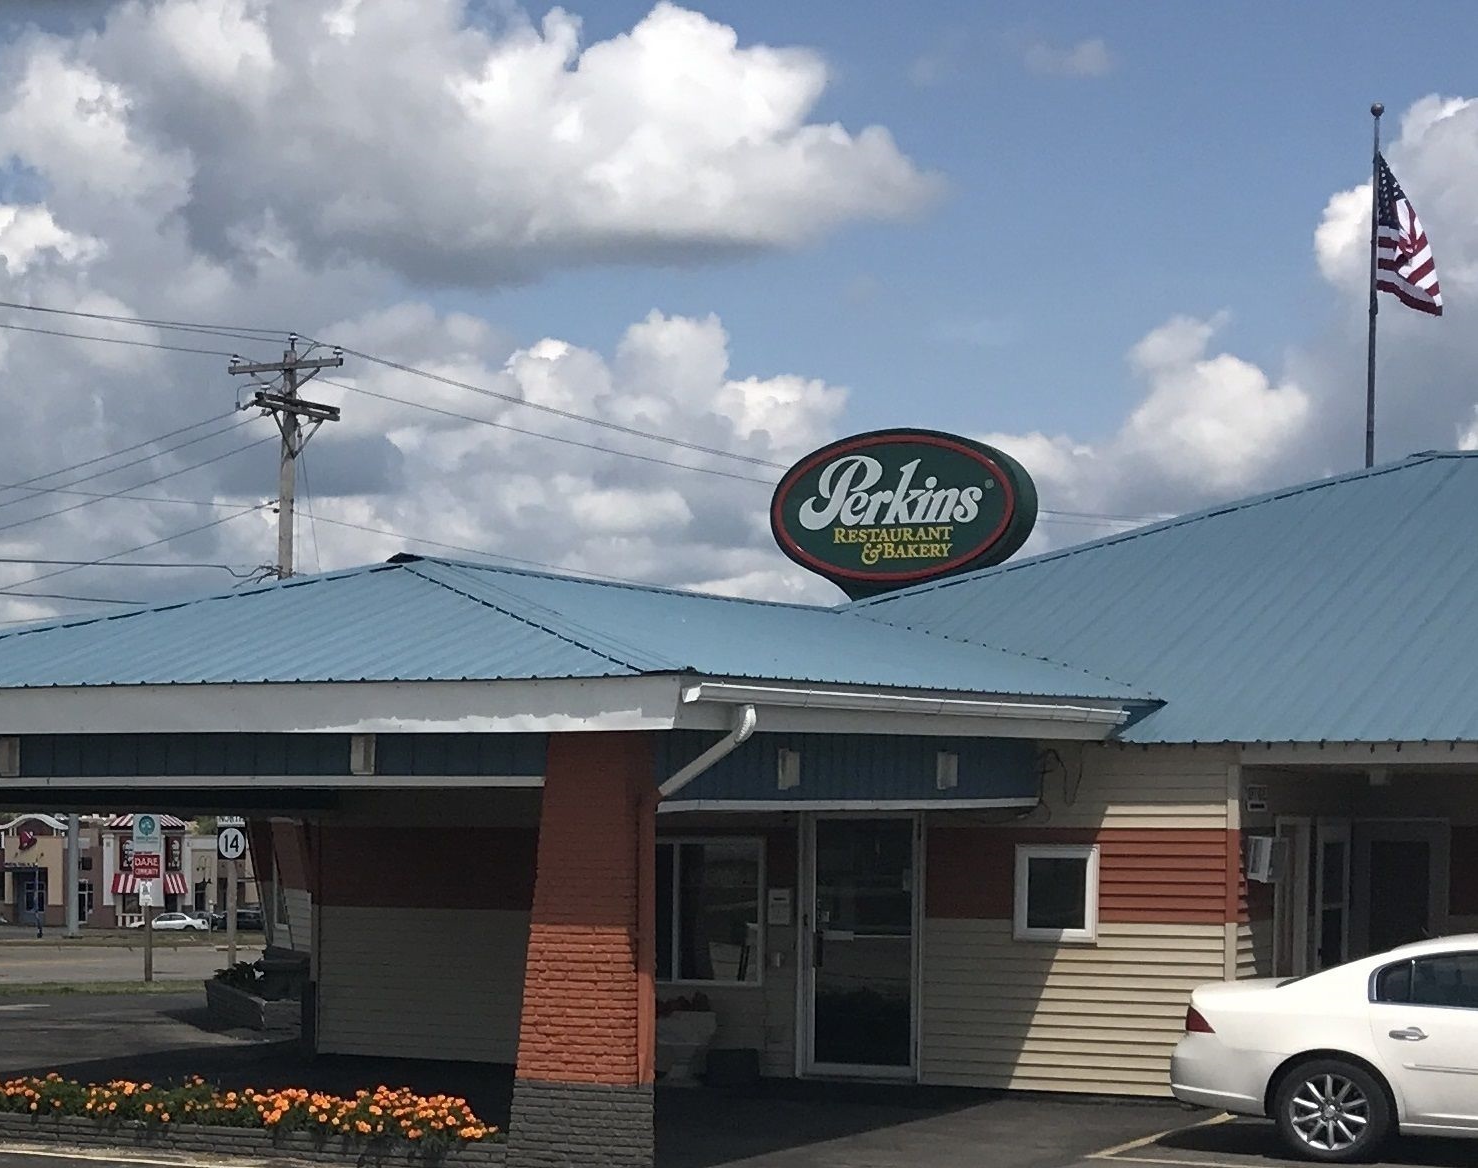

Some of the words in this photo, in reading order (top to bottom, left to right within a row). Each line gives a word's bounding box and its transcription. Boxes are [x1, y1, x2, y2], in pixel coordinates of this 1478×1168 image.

[799, 455, 983, 530] Perkins
[833, 526, 954, 544] RESTAURANT
[224, 834, 239, 853] 14
[134, 857, 158, 867] DARE
